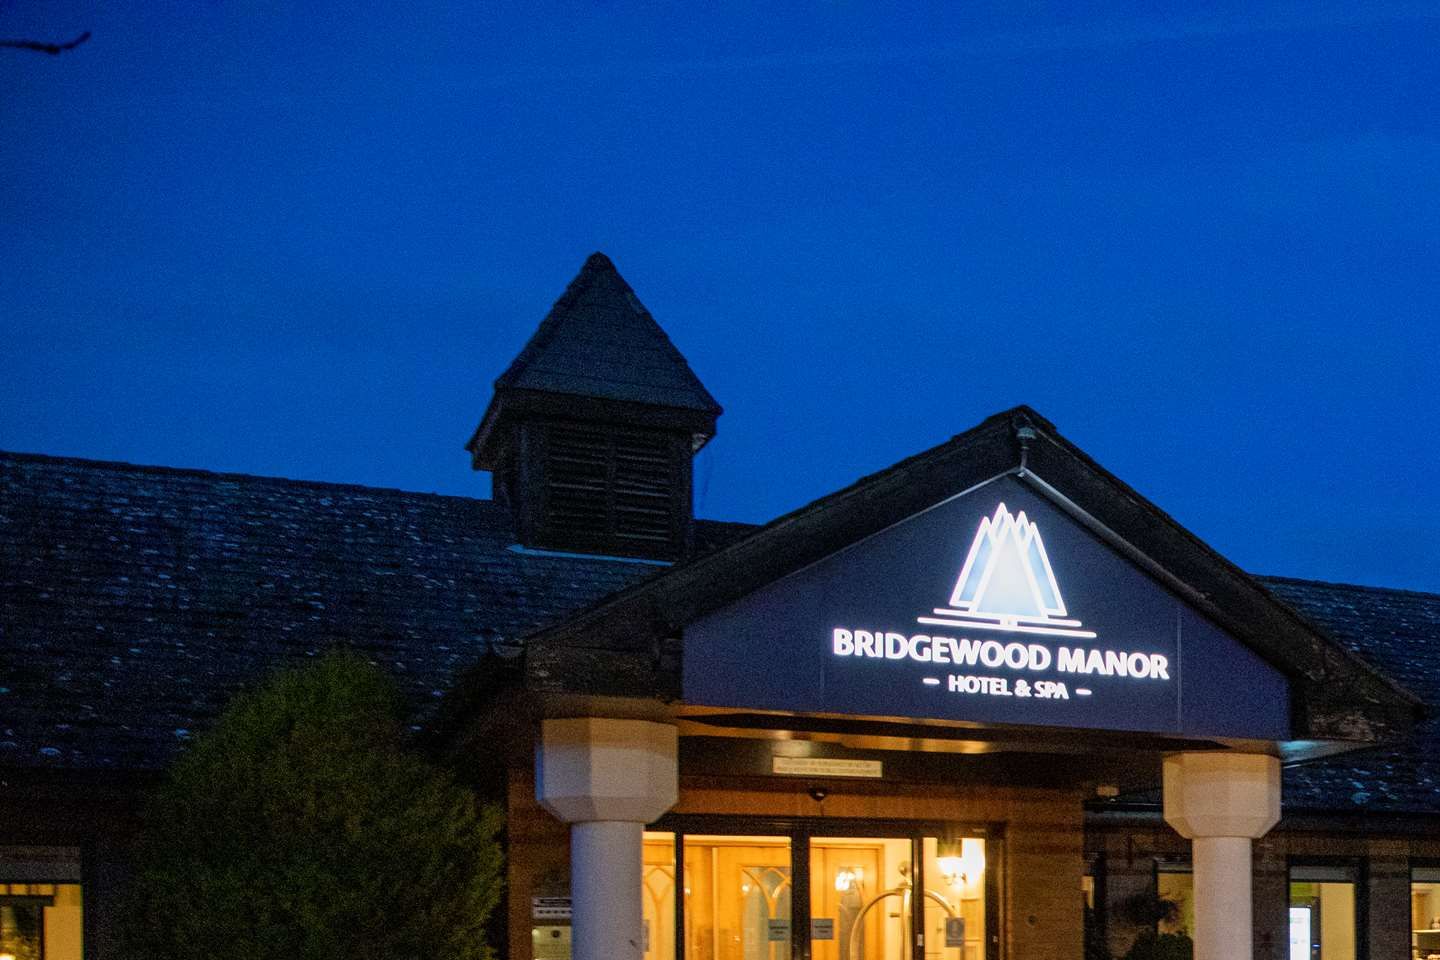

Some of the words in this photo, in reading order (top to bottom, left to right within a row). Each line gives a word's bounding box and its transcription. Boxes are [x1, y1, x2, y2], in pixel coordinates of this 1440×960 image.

[833, 628, 1051, 671] BRIDGEWOOD
[1058, 646, 1170, 680] MANOR
[948, 674, 1012, 697] HOTEL
[1014, 679, 1032, 698] &
[1034, 680, 1070, 700] SPA
